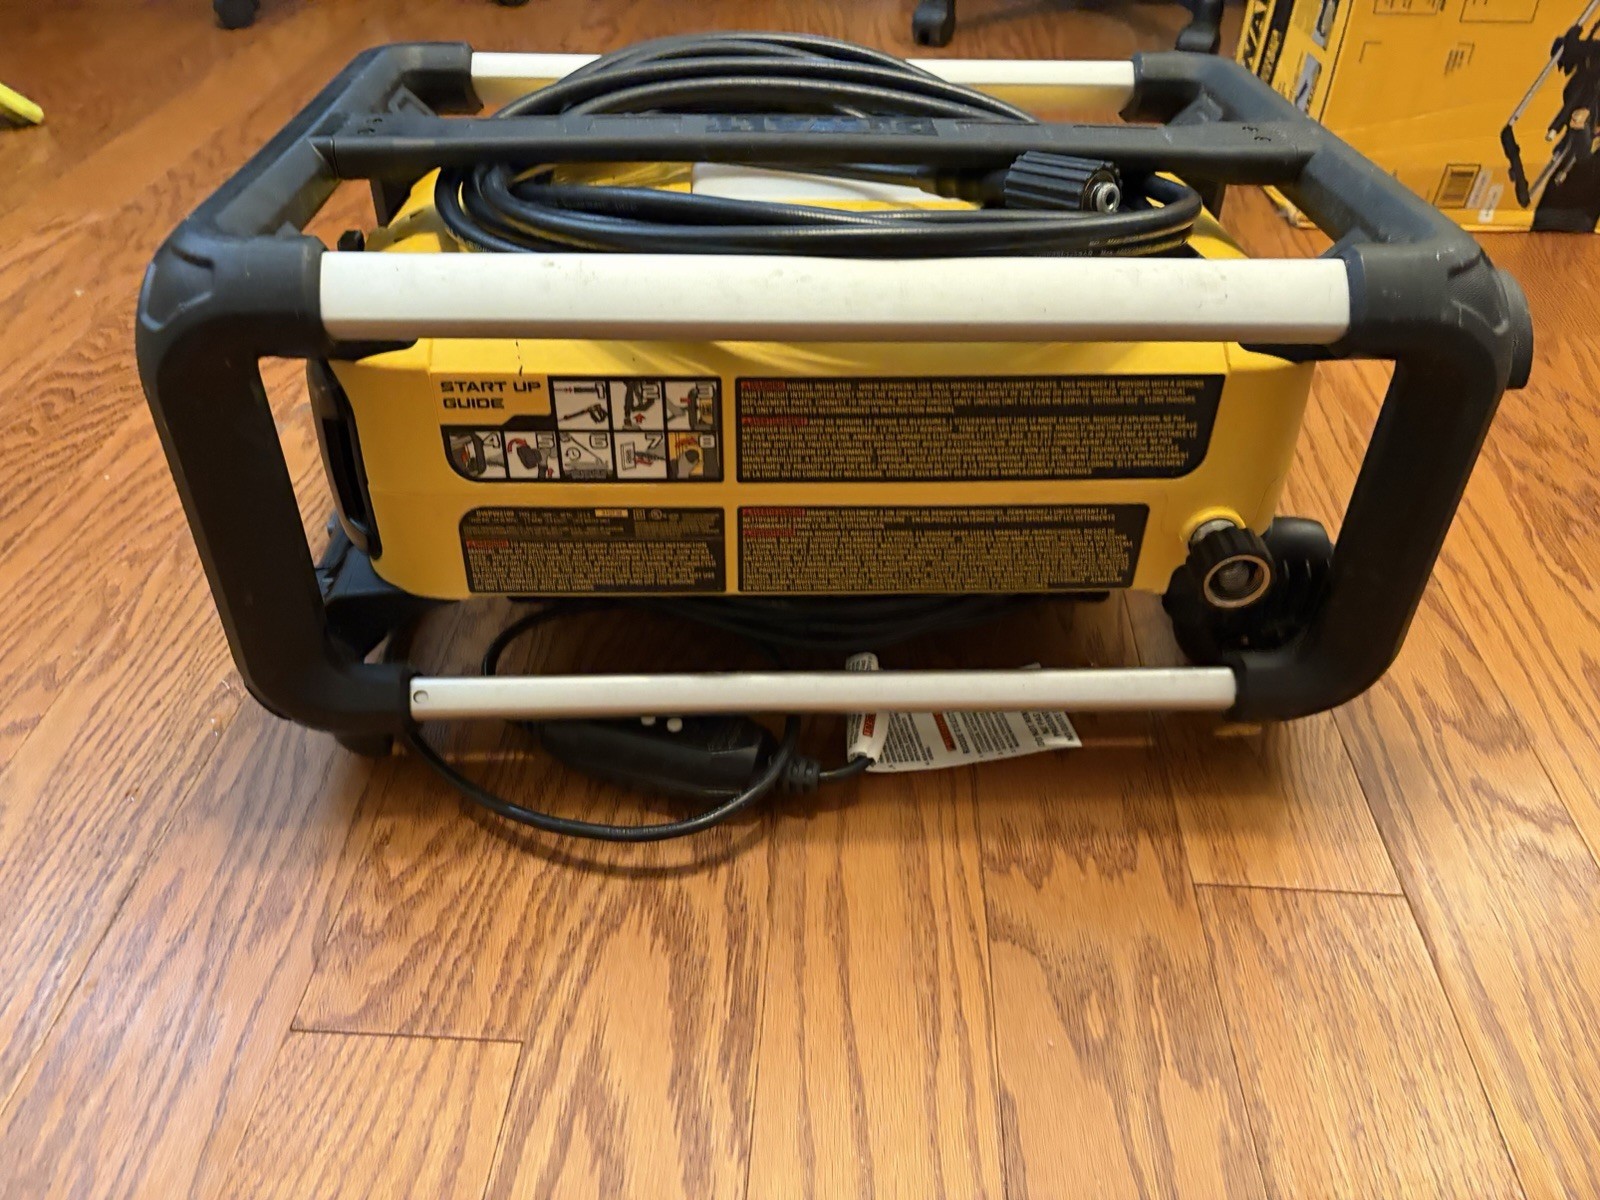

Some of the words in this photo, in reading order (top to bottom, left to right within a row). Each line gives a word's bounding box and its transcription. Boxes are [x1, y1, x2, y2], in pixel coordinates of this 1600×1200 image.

[441, 381, 507, 392] START
[513, 381, 541, 392] UP
[443, 397, 505, 409] GUIDE
